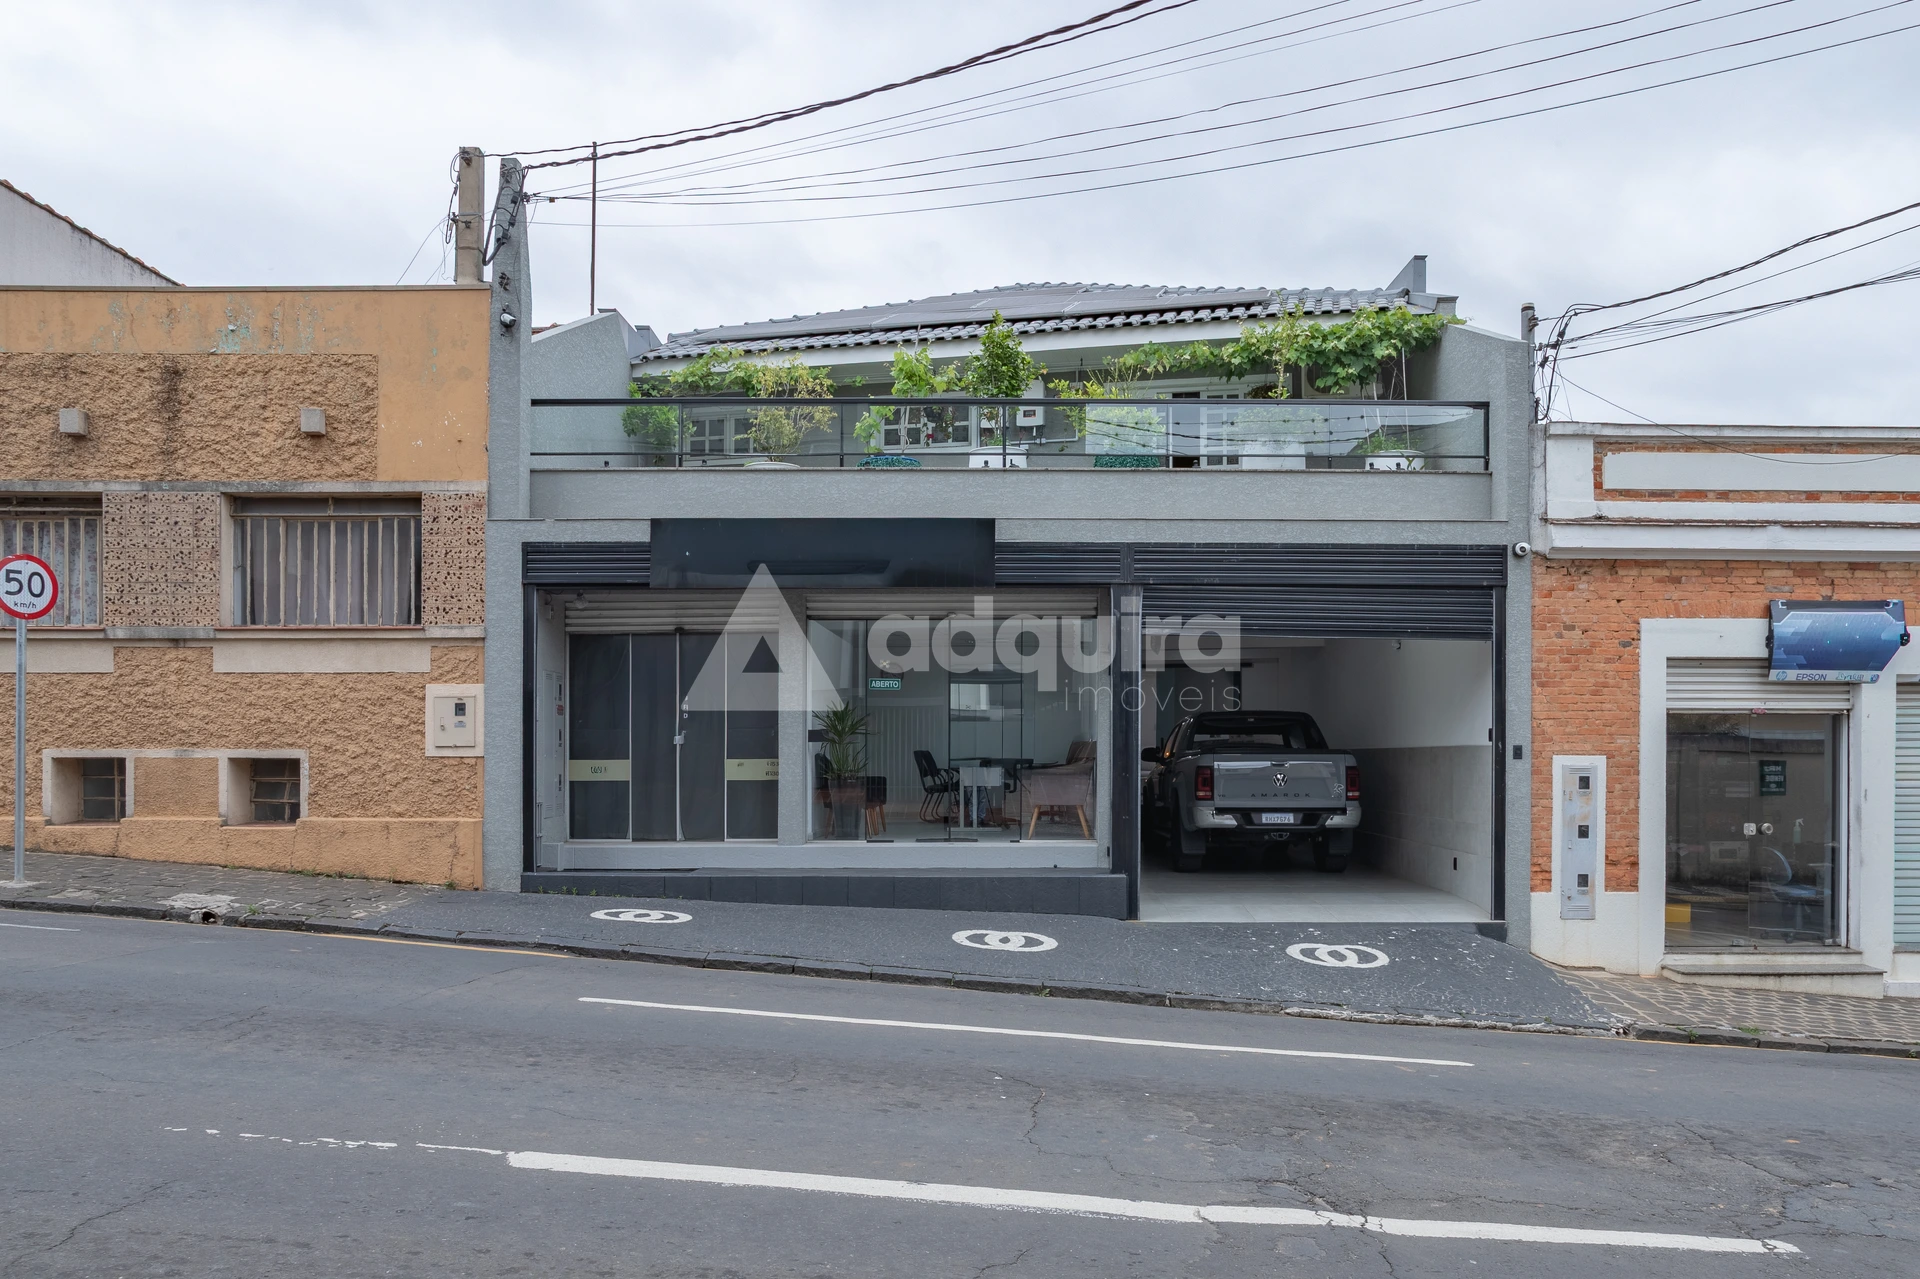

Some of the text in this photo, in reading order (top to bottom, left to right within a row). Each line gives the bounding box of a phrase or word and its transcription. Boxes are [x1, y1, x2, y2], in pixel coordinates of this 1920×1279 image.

[5, 569, 45, 598] 50
[14, 601, 37, 609] km/h
[1796, 673, 1827, 681] EPSON
[871, 680, 899, 688] ABERTO
